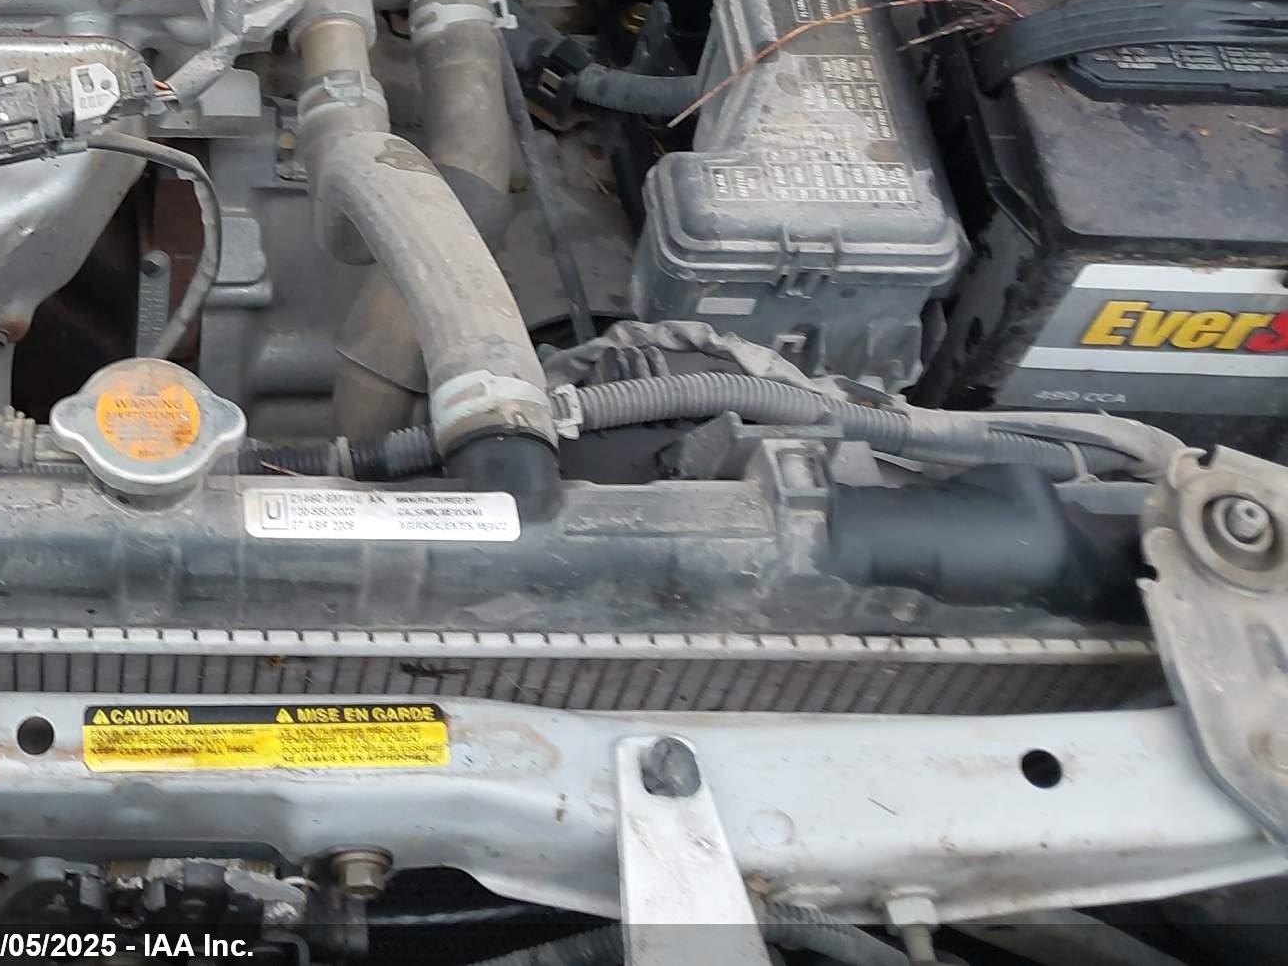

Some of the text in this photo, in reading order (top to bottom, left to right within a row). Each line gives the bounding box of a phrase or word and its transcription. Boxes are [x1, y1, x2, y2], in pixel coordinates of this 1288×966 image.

[1084, 392, 1127, 403] CCA
[110, 709, 190, 725] CAUTION
[296, 706, 436, 723] MISE EN GARDE
